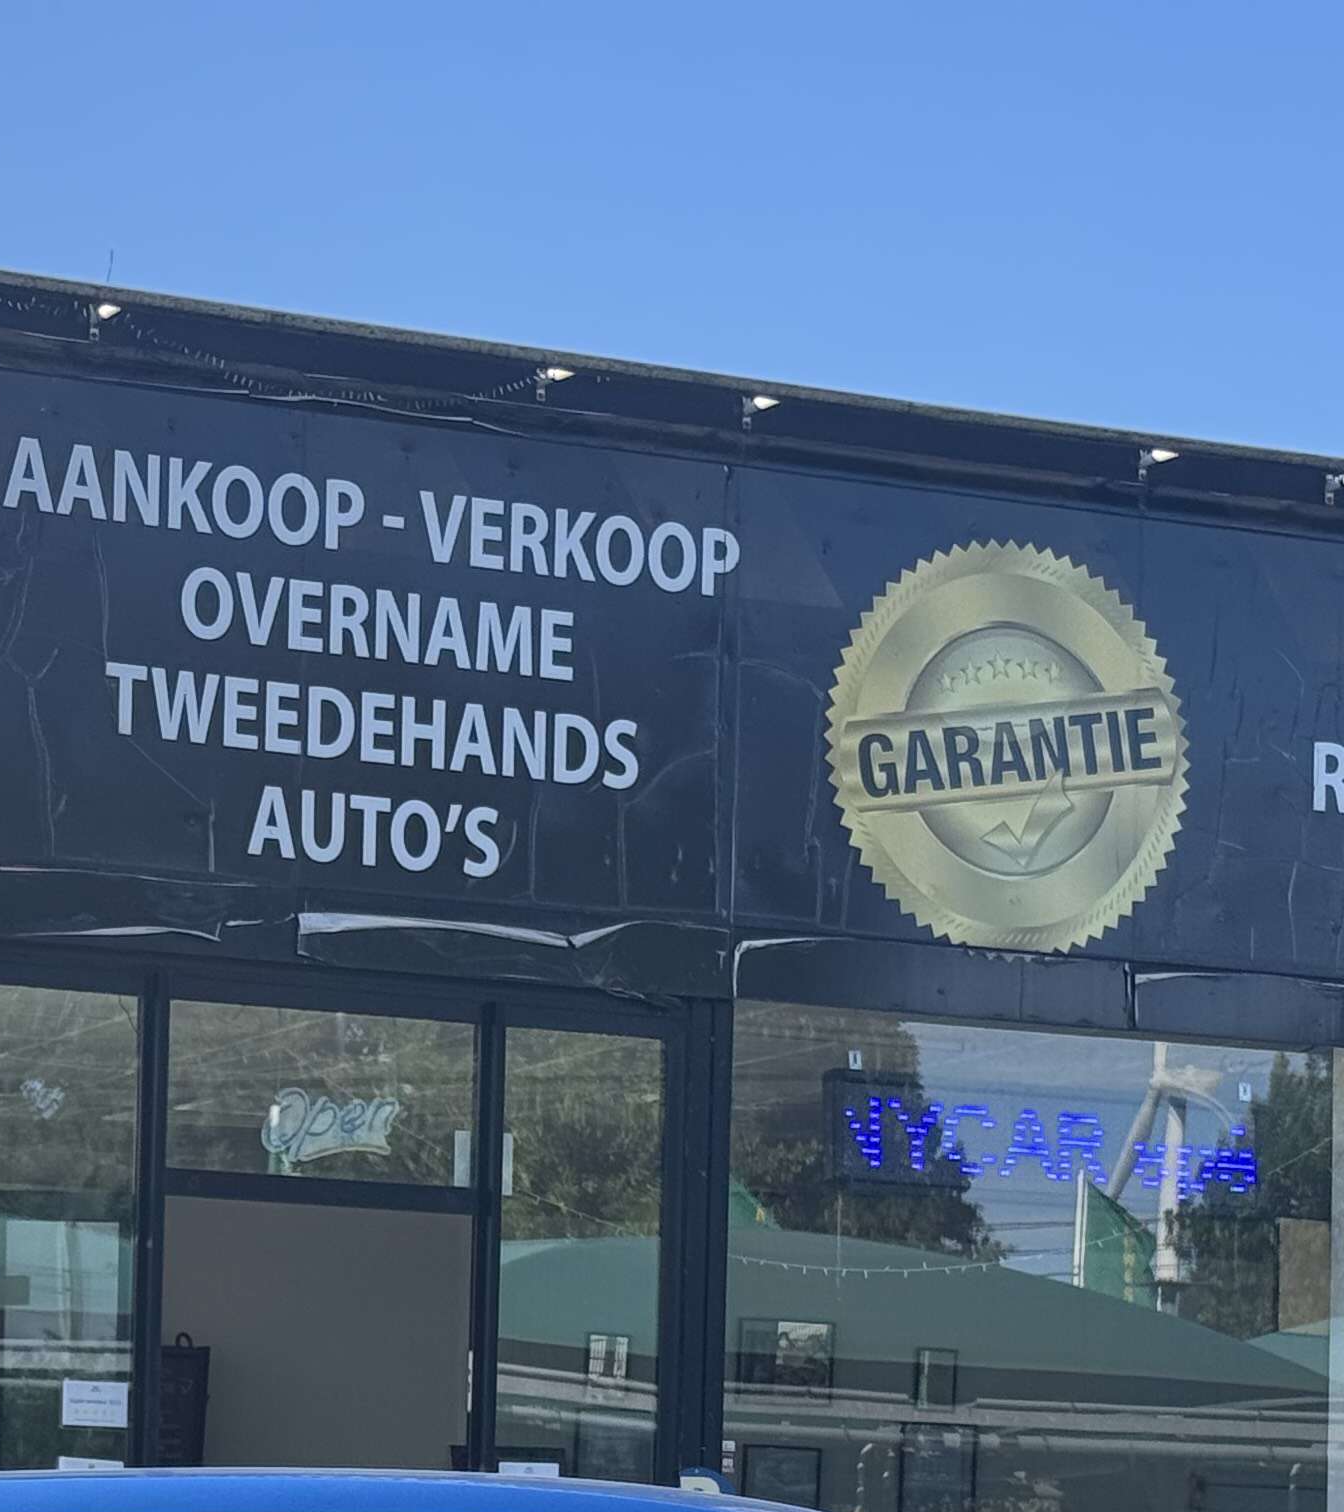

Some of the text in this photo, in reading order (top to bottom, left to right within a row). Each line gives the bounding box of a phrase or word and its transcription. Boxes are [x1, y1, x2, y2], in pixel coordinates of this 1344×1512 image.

[2, 436, 366, 551] AANKOOP
[419, 489, 742, 597] VERKOOP
[180, 565, 576, 682] OVERNAME
[104, 661, 640, 791] TWEEDEHANDS
[857, 706, 1163, 799] GARANTIE
[264, 1089, 399, 1161] Open
